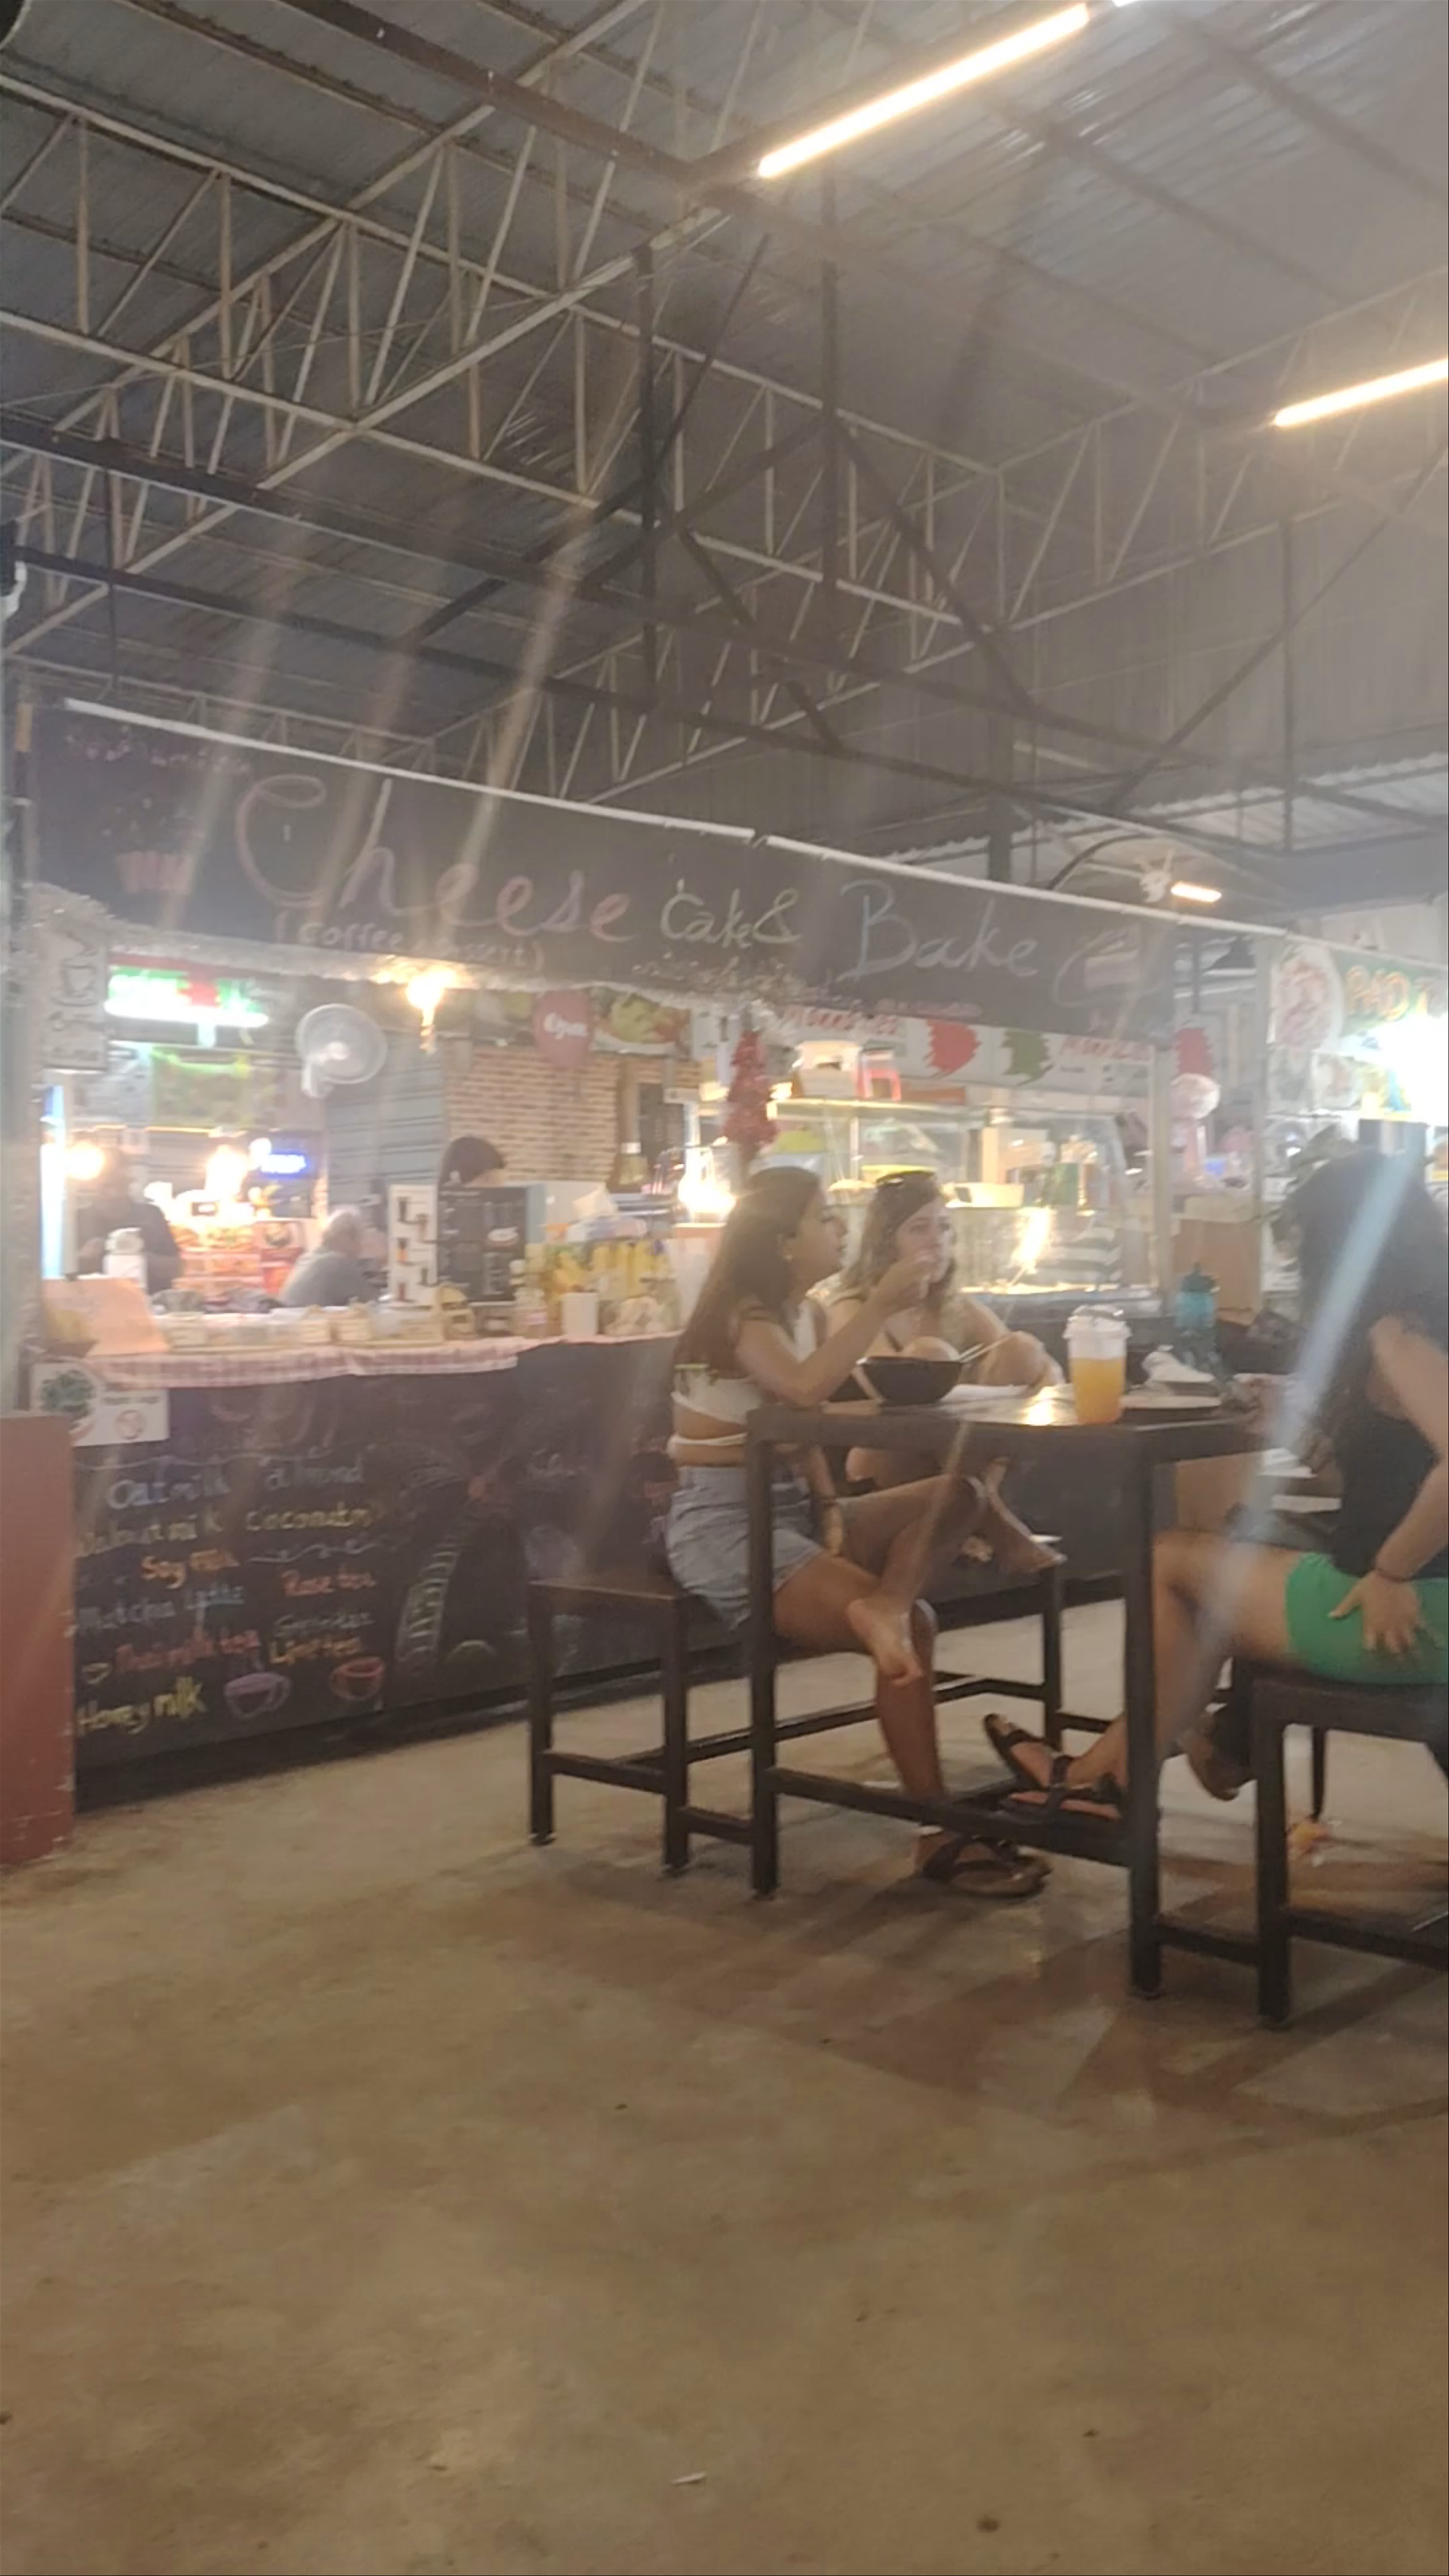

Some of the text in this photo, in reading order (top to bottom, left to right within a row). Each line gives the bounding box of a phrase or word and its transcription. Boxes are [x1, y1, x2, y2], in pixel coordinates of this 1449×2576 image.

[235, 773, 641, 943] Cheese
[660, 887, 752, 949] Cake
[835, 878, 1038, 983] Bake
